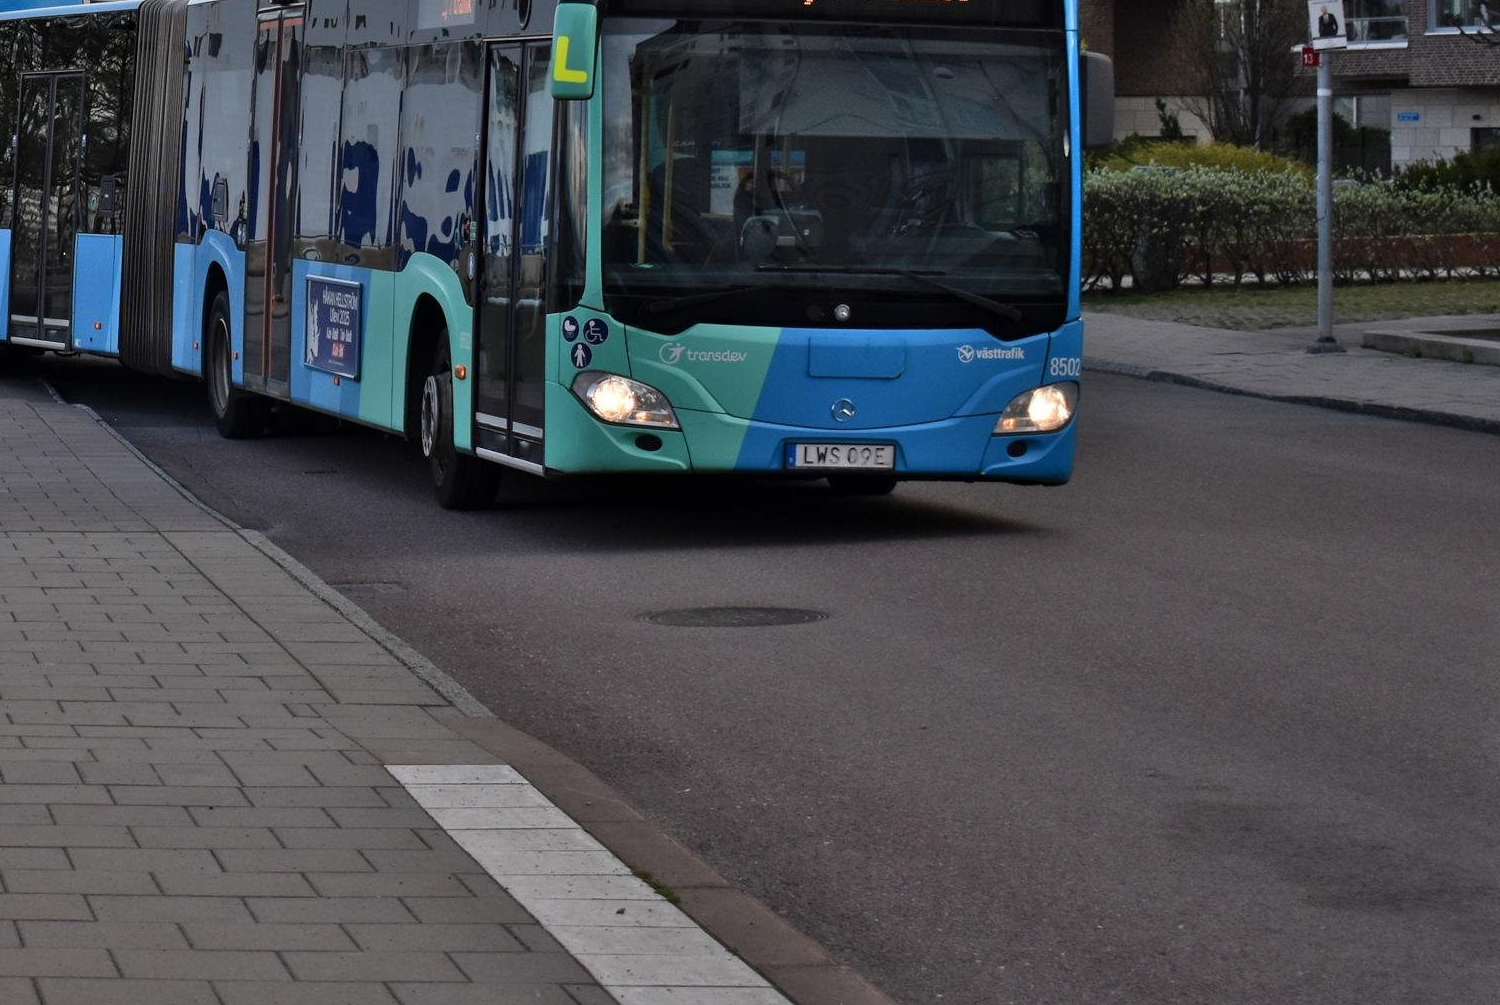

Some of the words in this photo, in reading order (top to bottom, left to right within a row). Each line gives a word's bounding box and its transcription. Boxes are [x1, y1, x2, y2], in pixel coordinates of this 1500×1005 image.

[554, 36, 588, 83] L
[1304, 53, 1314, 64] 13
[687, 349, 748, 362] transdev
[976, 347, 1025, 360] västtrafik
[1050, 357, 1081, 376] 8502
[804, 446, 840, 465] LWS
